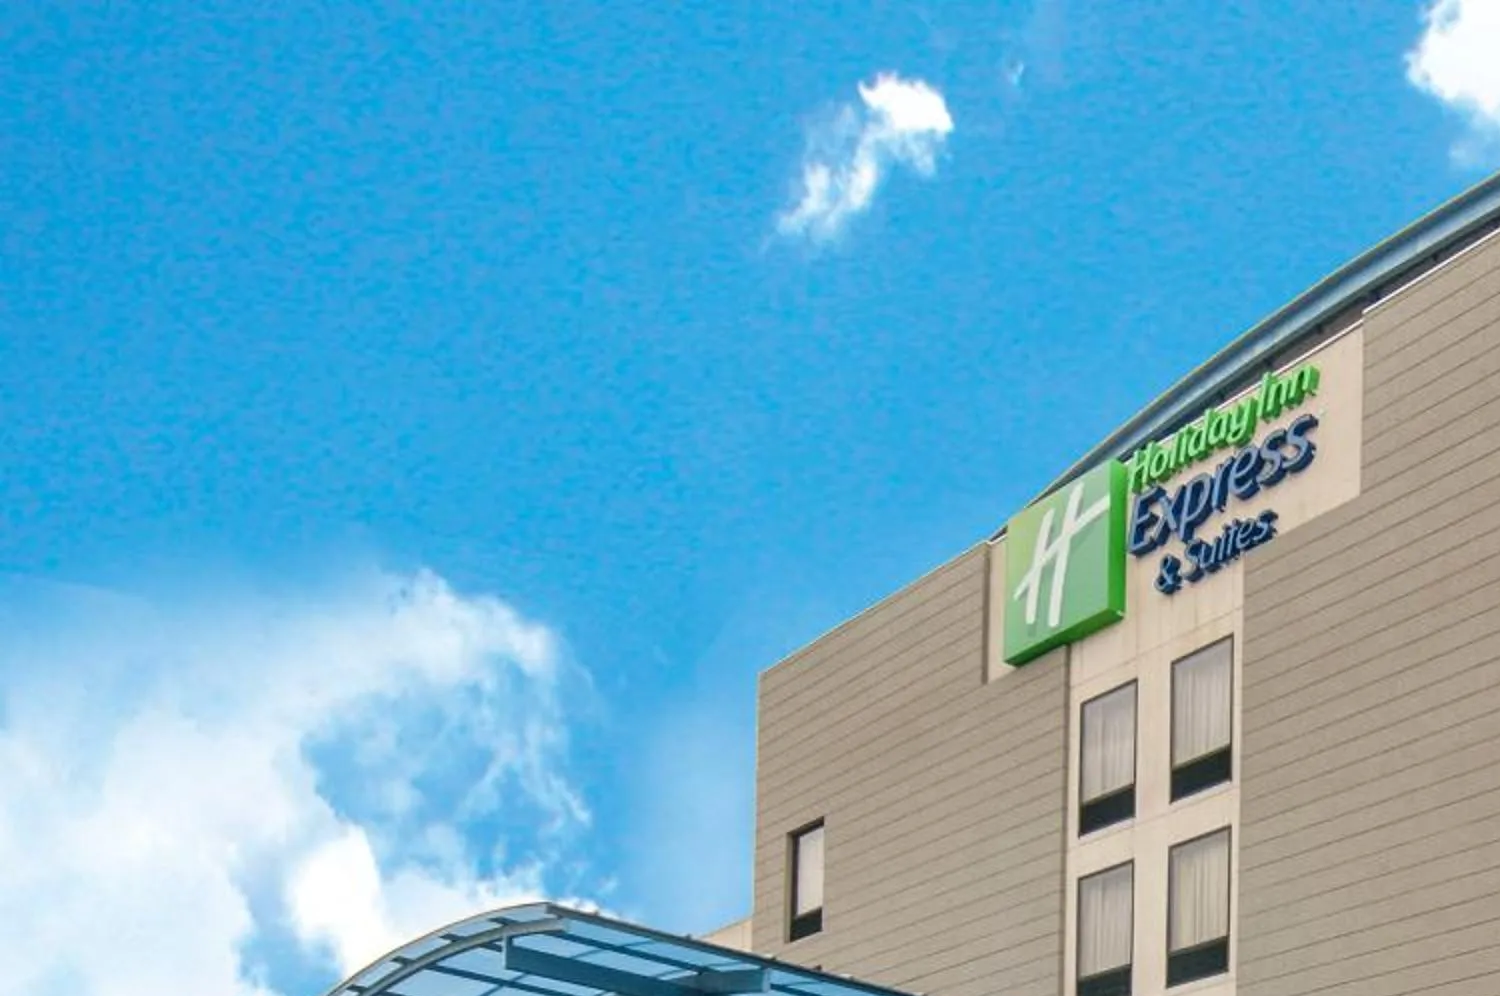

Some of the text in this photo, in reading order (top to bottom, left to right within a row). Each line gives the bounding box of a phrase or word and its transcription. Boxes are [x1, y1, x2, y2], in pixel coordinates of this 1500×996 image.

[1128, 413, 1319, 557] Express
[1130, 364, 1320, 493] Holiday Inn
[1012, 481, 1110, 628] H
[1154, 509, 1279, 596] & Suites
